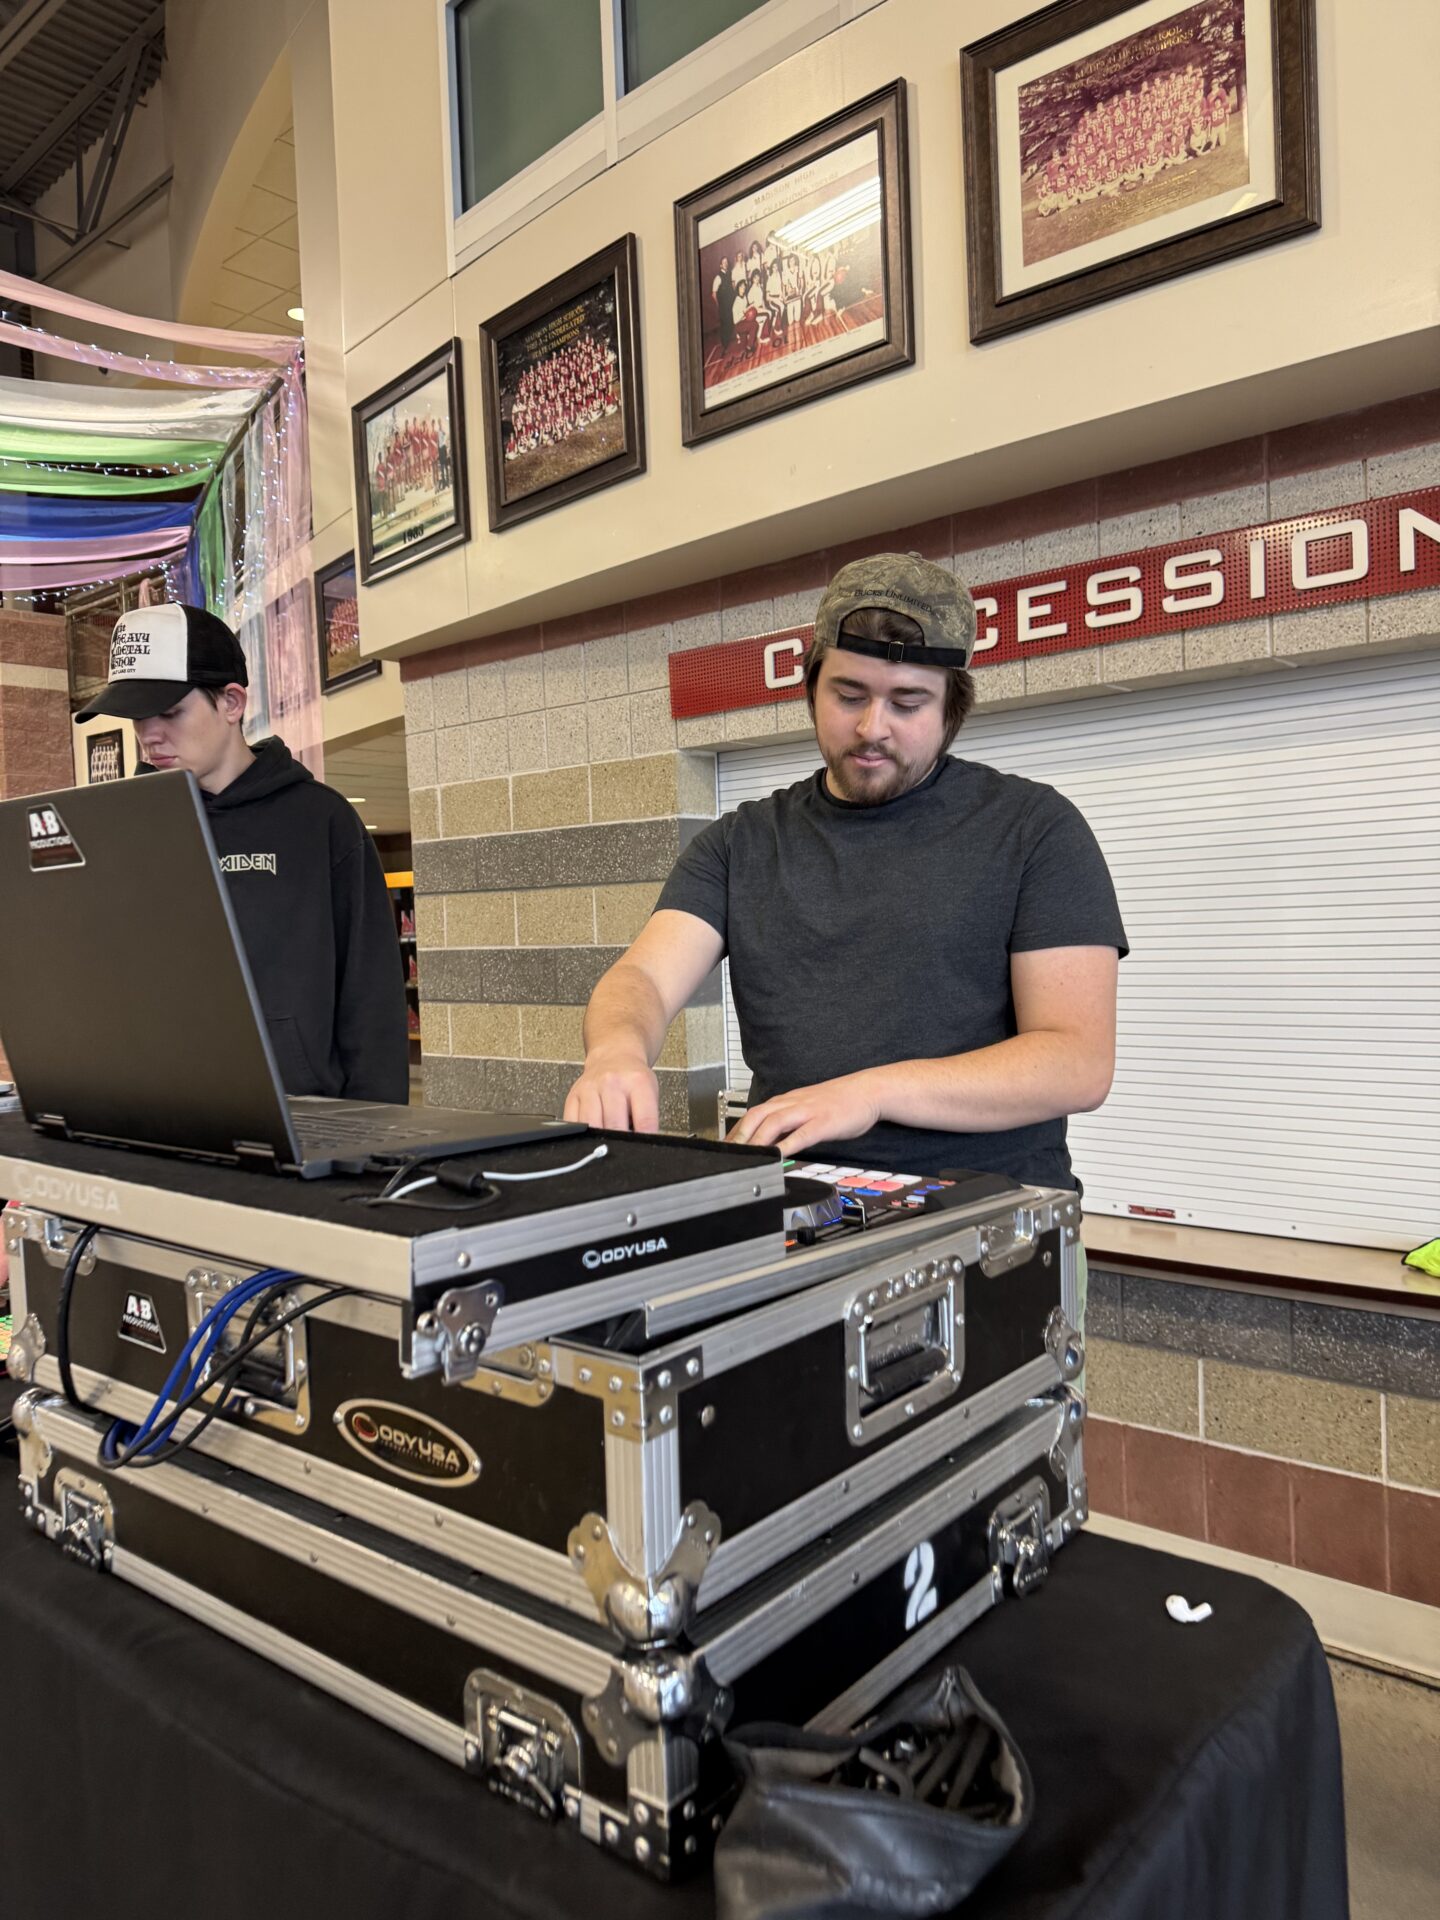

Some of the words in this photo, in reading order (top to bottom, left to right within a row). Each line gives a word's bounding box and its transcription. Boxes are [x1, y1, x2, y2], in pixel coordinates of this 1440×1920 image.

[754, 183, 790, 206] MADISON
[733, 214, 759, 230] STATE
[549, 328, 580, 350] CHAMPIONS
[885, 588, 933, 613] UNLIMITED
[218, 853, 276, 875] AIDEN
[904, 1541, 937, 1631] 2
